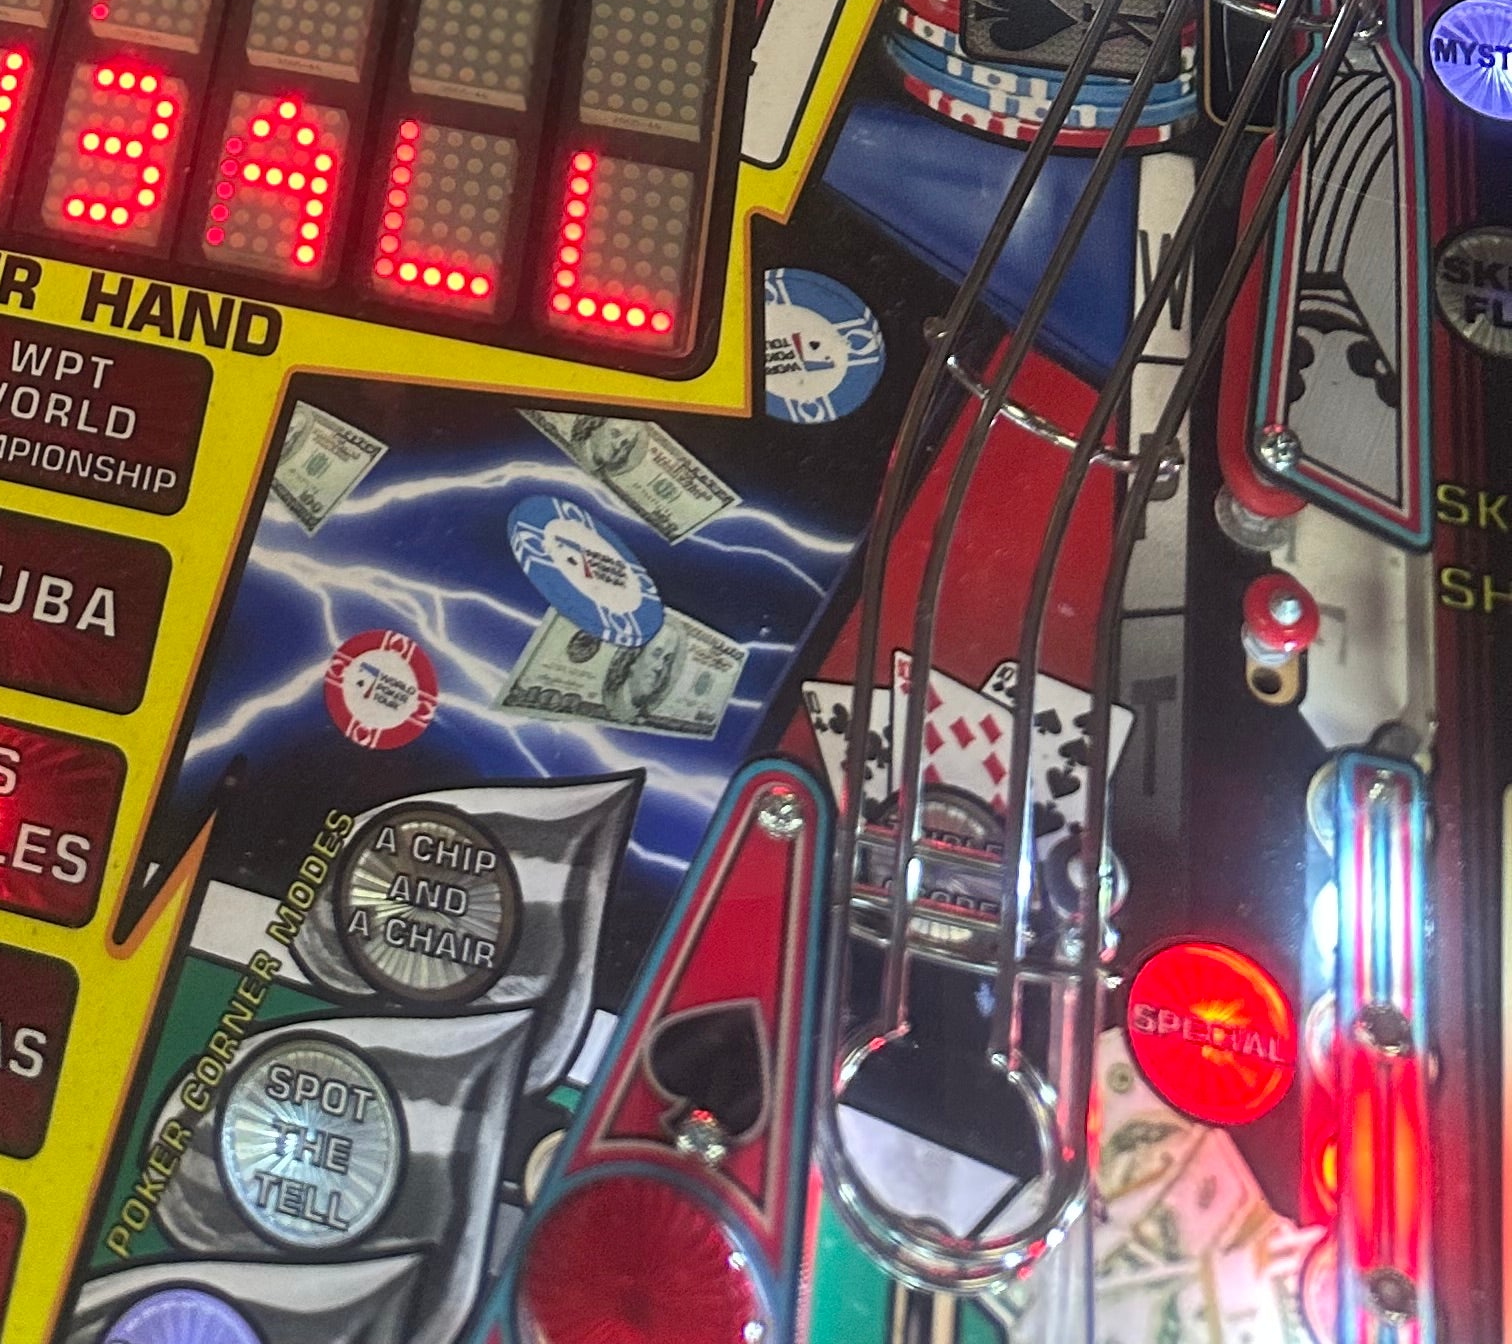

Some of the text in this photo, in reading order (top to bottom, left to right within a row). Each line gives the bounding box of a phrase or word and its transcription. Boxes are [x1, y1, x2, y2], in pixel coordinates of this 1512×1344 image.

[80, 271, 284, 357] HAND
[10, 339, 115, 390] WPT
[375, 825, 498, 876] A CHIP
[388, 873, 468, 917] AND
[347, 908, 497, 968] A CHAIR
[106, 807, 356, 1259] POKER CORNER MODES
[1130, 1000, 1288, 1065] SPECIAL
[267, 1061, 375, 1124] SPOT
[271, 1120, 351, 1175] THE
[255, 1171, 350, 1232] TELL
